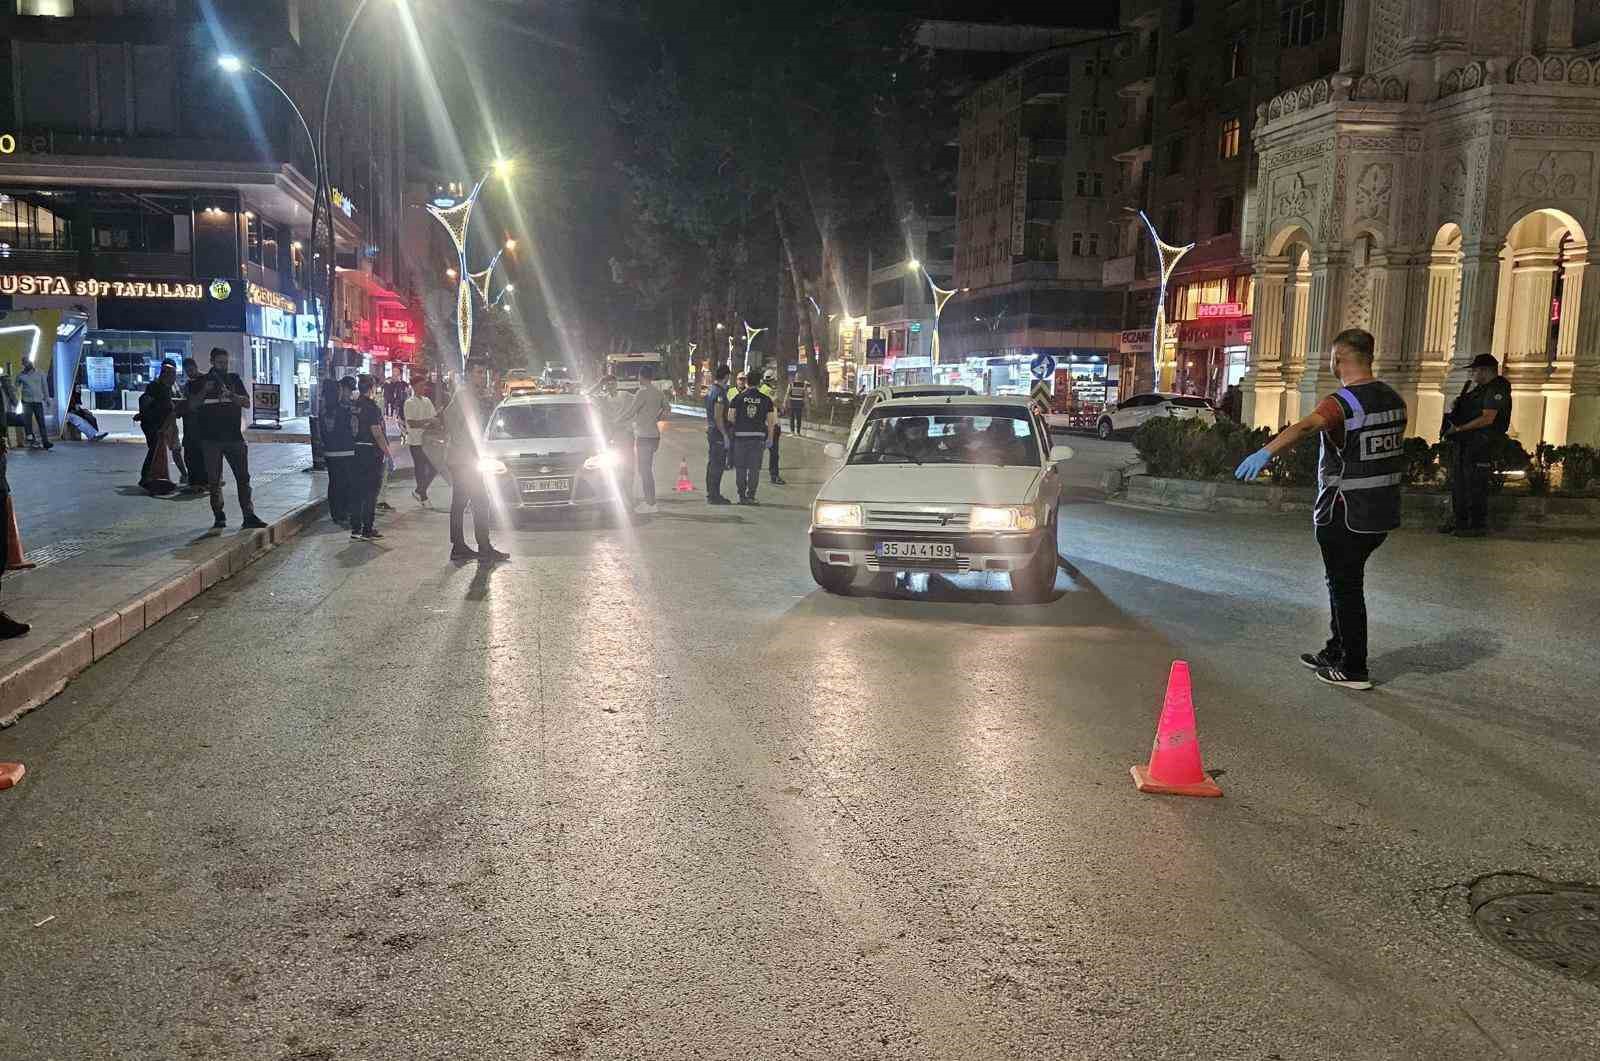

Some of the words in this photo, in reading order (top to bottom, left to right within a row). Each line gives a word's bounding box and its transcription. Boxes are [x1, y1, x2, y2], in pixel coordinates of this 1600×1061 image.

[0, 275, 71, 295] USTA
[1199, 304, 1242, 316] HOTEL
[883, 543, 898, 555] 35
[902, 544, 917, 556] JA
[920, 545, 952, 557] 4199
